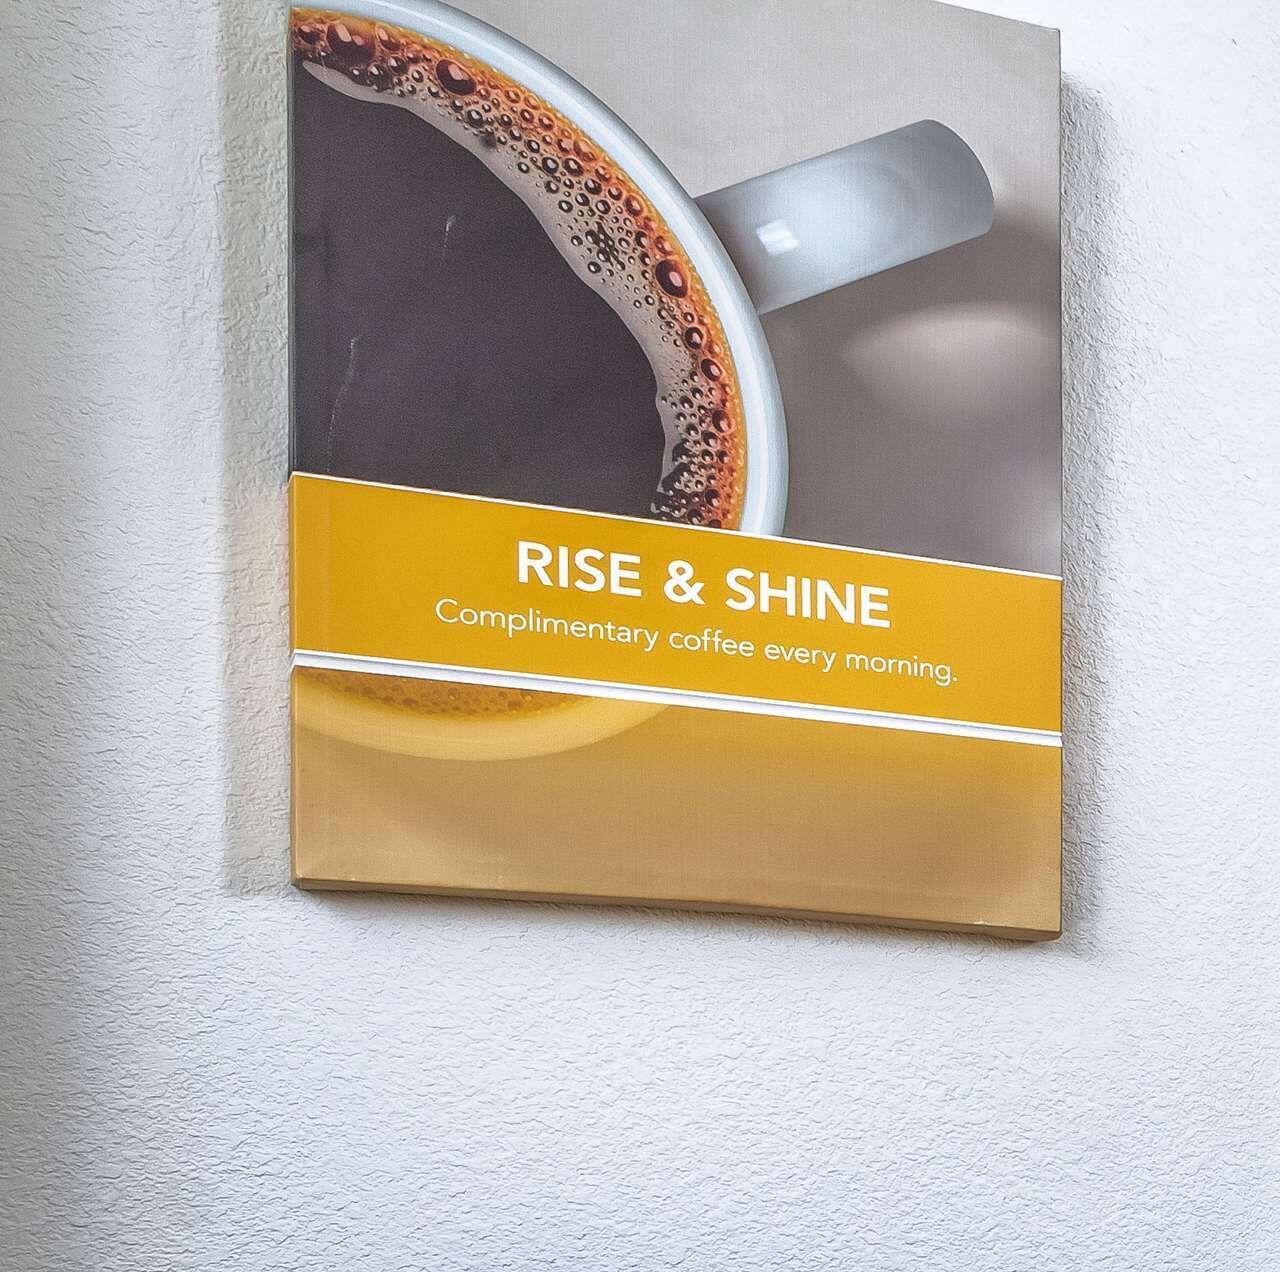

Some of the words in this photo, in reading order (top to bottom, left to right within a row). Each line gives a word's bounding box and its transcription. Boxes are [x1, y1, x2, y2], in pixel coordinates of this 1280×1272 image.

[515, 540, 643, 598] RISE
[663, 558, 706, 606] &
[724, 567, 892, 629] SHINE
[434, 598, 661, 653] Complimentary
[668, 628, 755, 659] coffee
[764, 640, 837, 674] every
[844, 648, 959, 688] morning.
